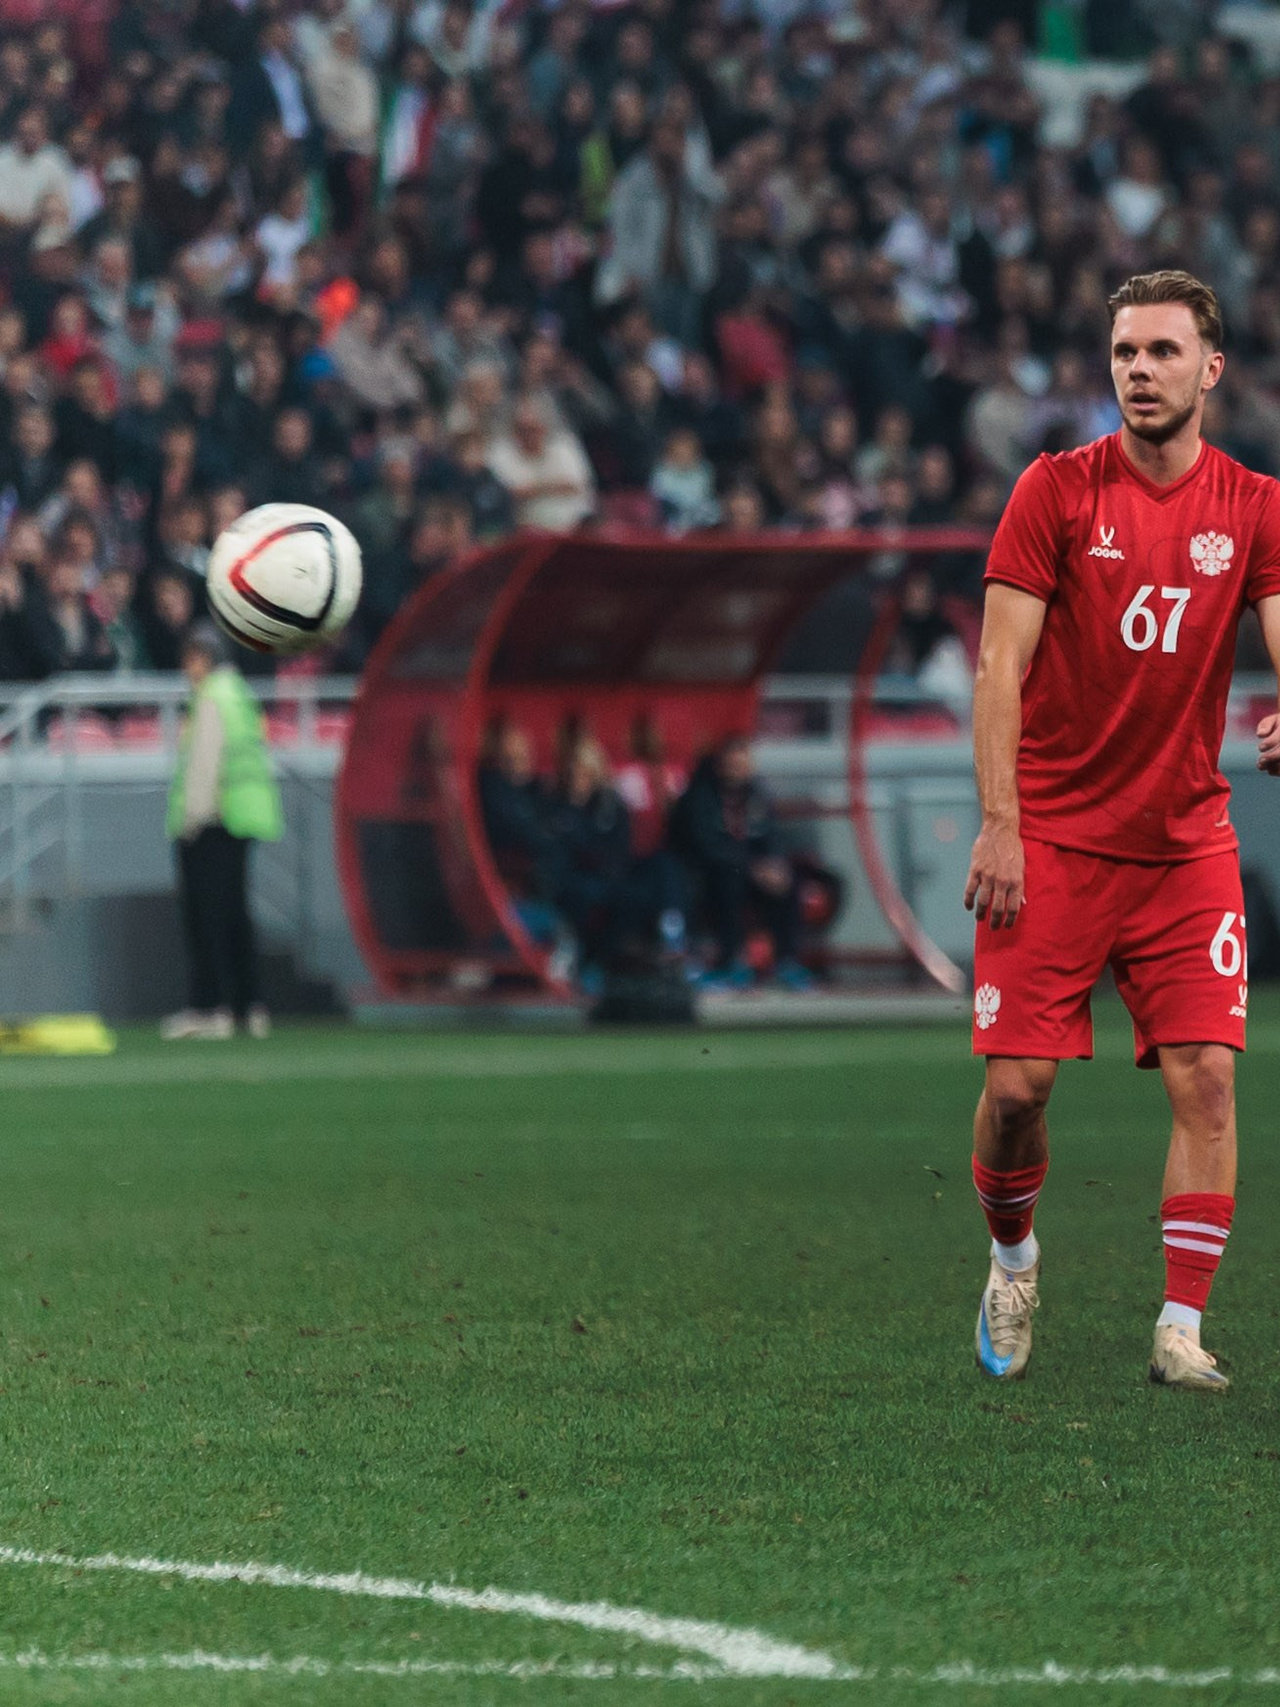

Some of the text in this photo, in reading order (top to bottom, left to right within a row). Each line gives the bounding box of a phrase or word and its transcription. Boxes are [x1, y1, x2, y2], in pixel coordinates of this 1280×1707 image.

[1087, 546, 1126, 560] JOGEL
[1120, 585, 1191, 653] 67
[1209, 911, 1248, 981] 6
